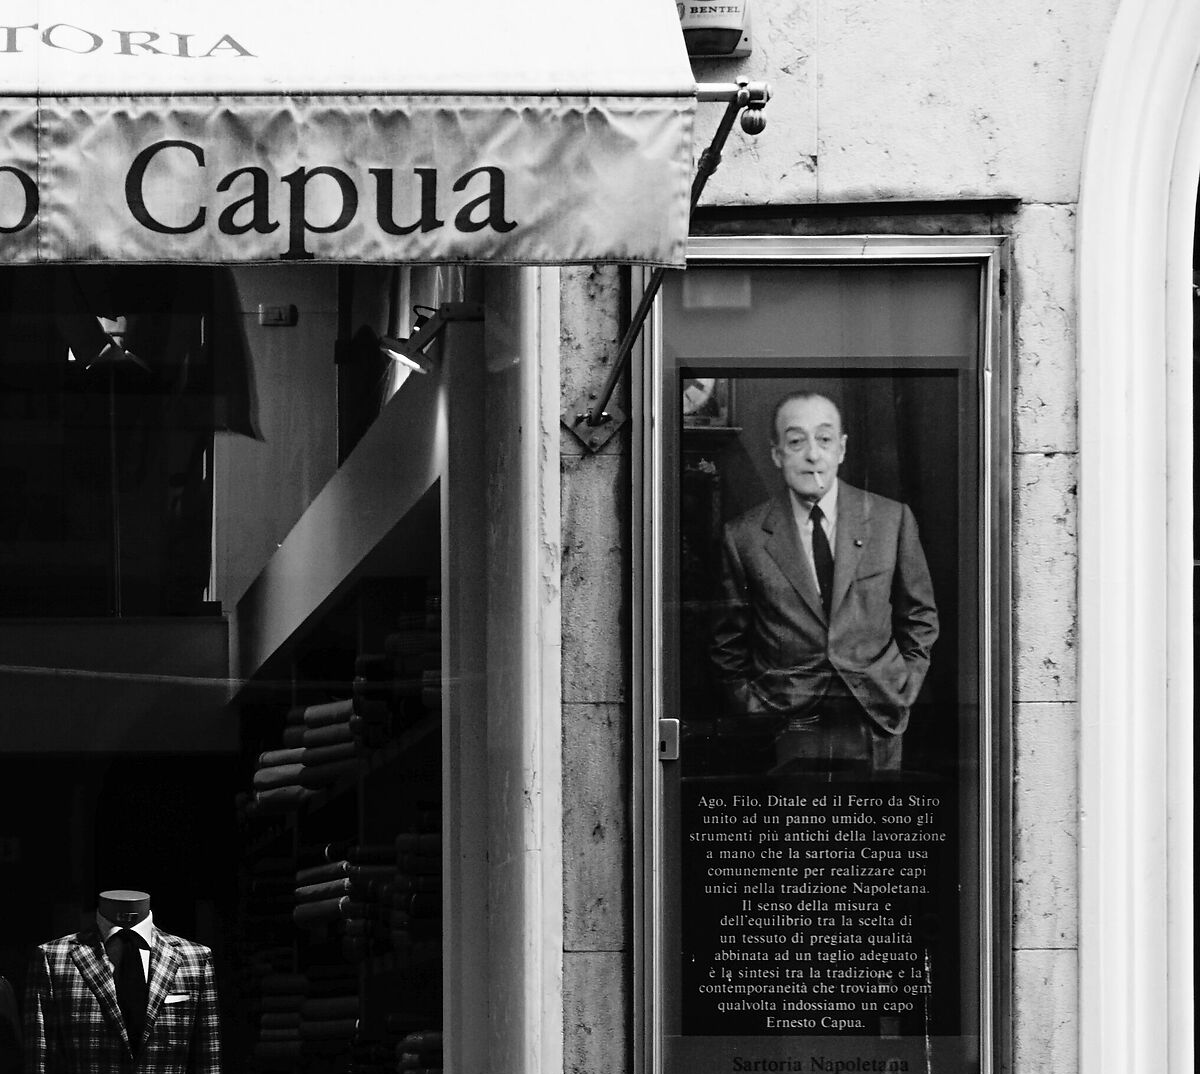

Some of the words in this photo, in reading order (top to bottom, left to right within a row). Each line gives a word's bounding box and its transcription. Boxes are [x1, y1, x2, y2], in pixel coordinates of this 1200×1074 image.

[689, 6, 741, 14] BENTEL
[124, 139, 518, 260] Capua
[767, 794, 808, 807] Ditale
[811, 795, 827, 807] ed
[832, 794, 842, 807] il
[847, 794, 884, 807] Ferro
[887, 795, 903, 807] da
[908, 794, 940, 807] Stiro
[703, 812, 738, 824] unito
[742, 812, 757, 824] ad
[763, 815, 780, 824] un
[785, 815, 827, 827] panno
[881, 815, 912, 824] sono
[916, 812, 934, 827] gli
[689, 829, 753, 842] strumenti
[783, 829, 830, 842] antichi
[834, 830, 866, 842] della
[872, 829, 947, 842] lavorazione
[719, 850, 756, 859] mano
[760, 847, 783, 859] che
[788, 847, 801, 859] la
[805, 847, 856, 859] sartoria
[860, 847, 902, 862] Capua
[907, 850, 929, 859] usa
[707, 866, 799, 877] comunemente
[803, 867, 825, 879] per
[830, 864, 895, 877] realizzare
[899, 865, 926, 879] capi
[704, 882, 738, 894] unici
[743, 882, 775, 894] nella
[780, 881, 848, 894] tradizione
[742, 899, 752, 911] Il
[757, 902, 793, 912] senso
[796, 899, 829, 912] della
[834, 899, 879, 912] misura
[817, 916, 836, 927] tra
[841, 914, 853, 927] la
[858, 914, 895, 927] scelta
[899, 914, 913, 927] di
[719, 935, 736, 944] un
[742, 934, 787, 944] tessuto
[790, 931, 804, 944] di
[809, 931, 863, 947] pregiata
[714, 949, 769, 961] abbinata
[774, 949, 790, 961] ad
[795, 952, 812, 961] un
[817, 949, 855, 964] taglio
[859, 949, 918, 964] adeguato
[720, 967, 733, 979] la
[738, 966, 780, 979] sintesi
[785, 968, 804, 979] tra
[809, 966, 822, 979] la
[826, 967, 893, 979] tradizione
[910, 967, 923, 979] la
[812, 982, 836, 994] che
[840, 981, 899, 994] troviamo
[903, 982, 933, 996] ogni
[717, 999, 777, 1013] qualvolta
[782, 999, 856, 1011] indossiamo
[860, 1002, 878, 1011] un
[883, 1002, 914, 1013] capo
[766, 1016, 817, 1028] Ernesto
[732, 1057, 802, 1073] Sartoria
[811, 1057, 909, 1074] Napoletana
